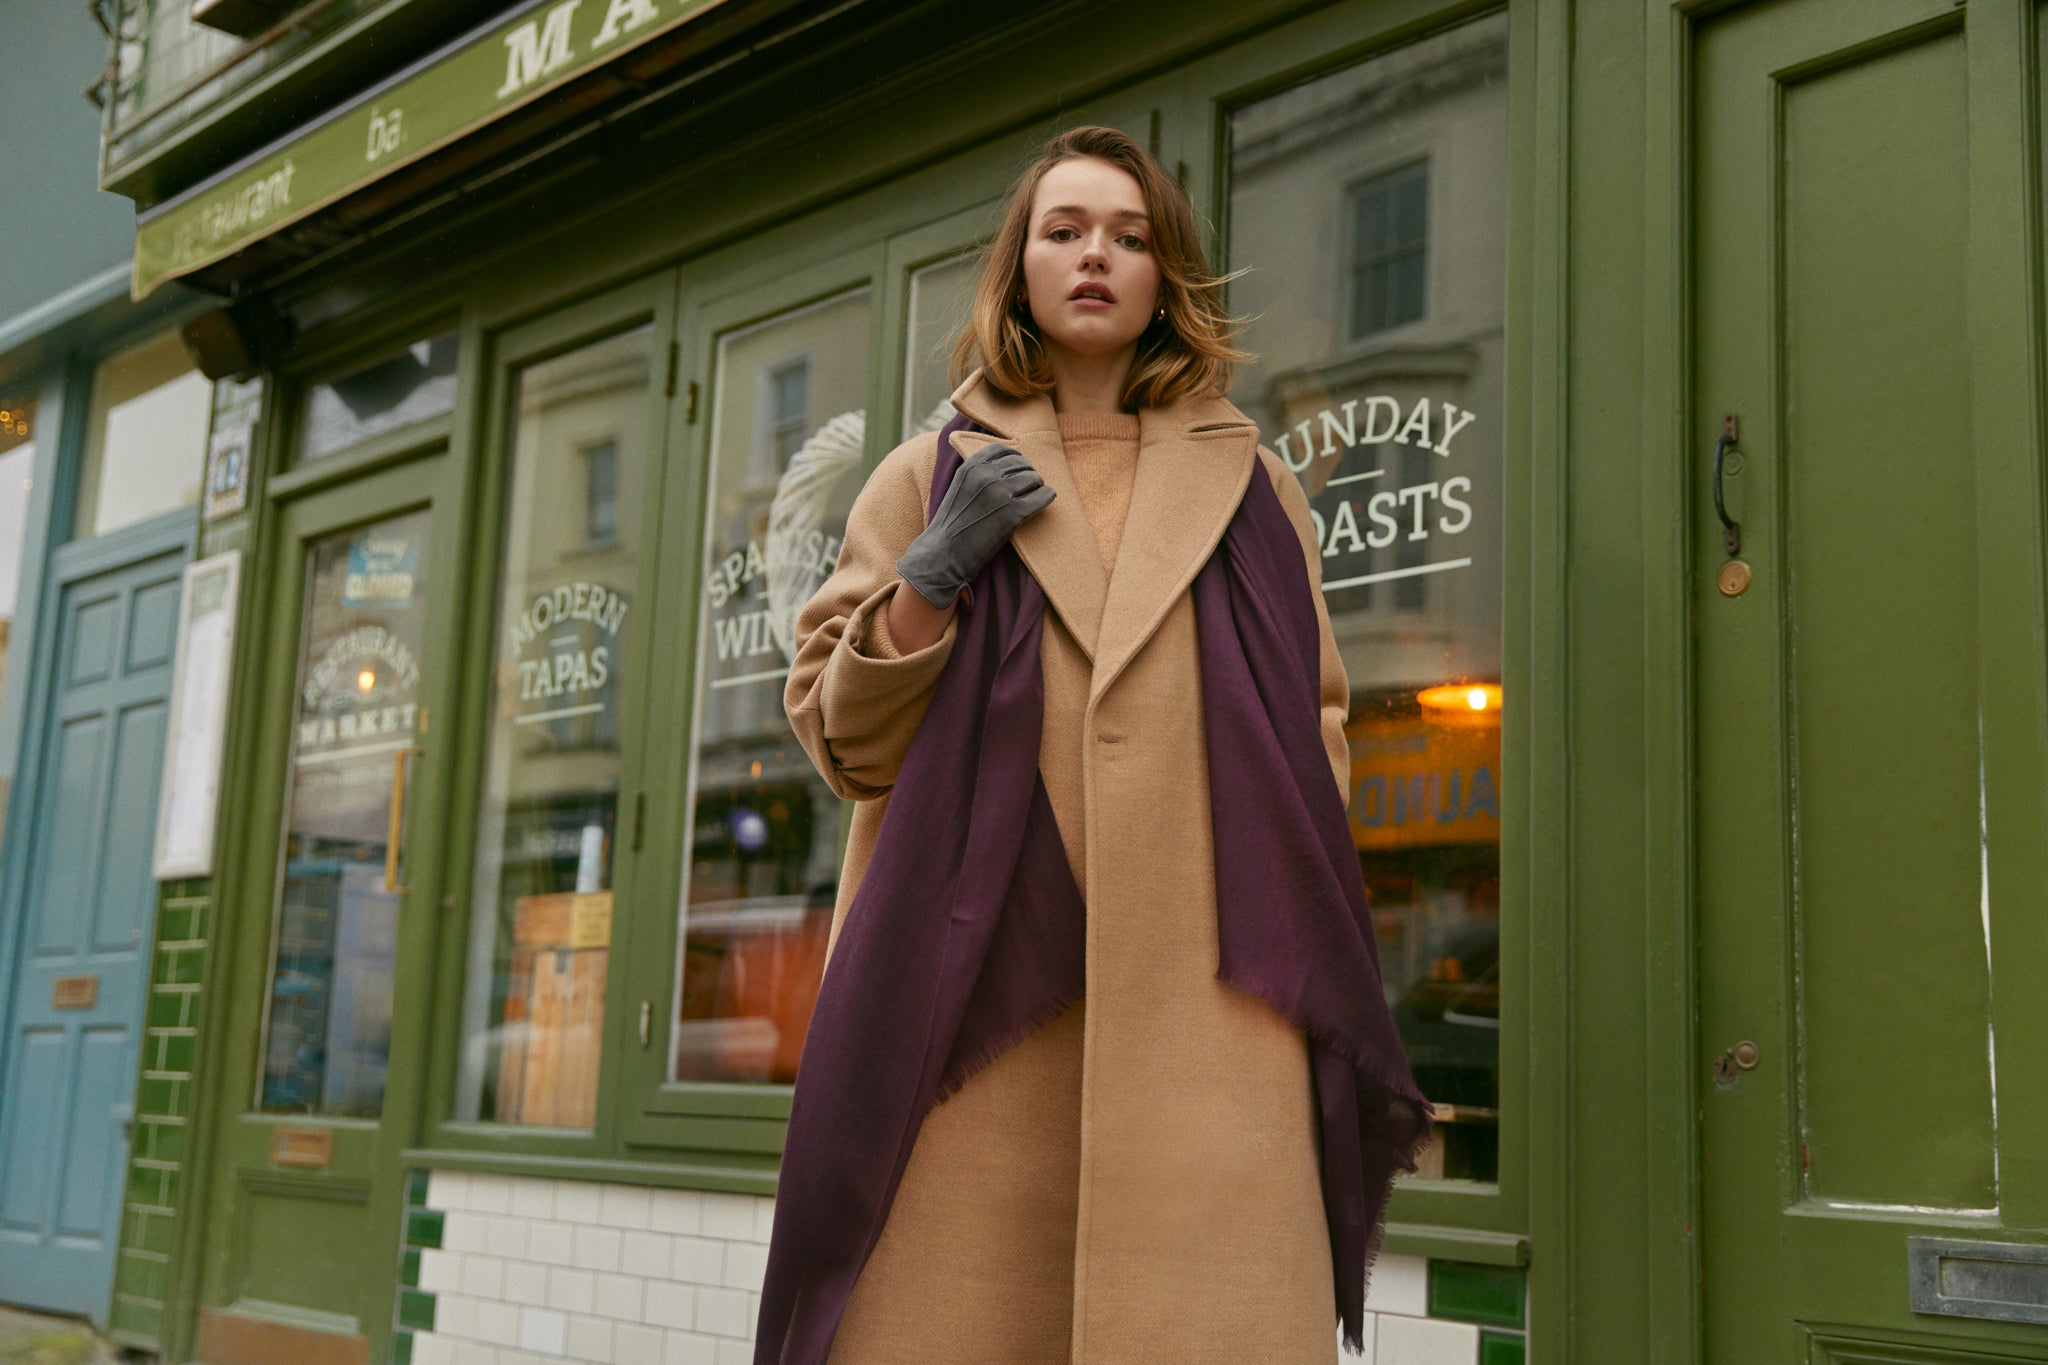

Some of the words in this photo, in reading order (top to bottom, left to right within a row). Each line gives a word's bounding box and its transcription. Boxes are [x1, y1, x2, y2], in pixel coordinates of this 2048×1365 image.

[498, 0, 691, 99] MA
[366, 105, 408, 162] ba
[172, 160, 296, 262] retaurant
[1274, 395, 1477, 474] UNDAY
[1310, 476, 1473, 558] ASTS
[510, 582, 629, 659] MODERN
[714, 606, 799, 662] WIN
[517, 646, 610, 701] TAPAS
[300, 703, 417, 746] MARKET
